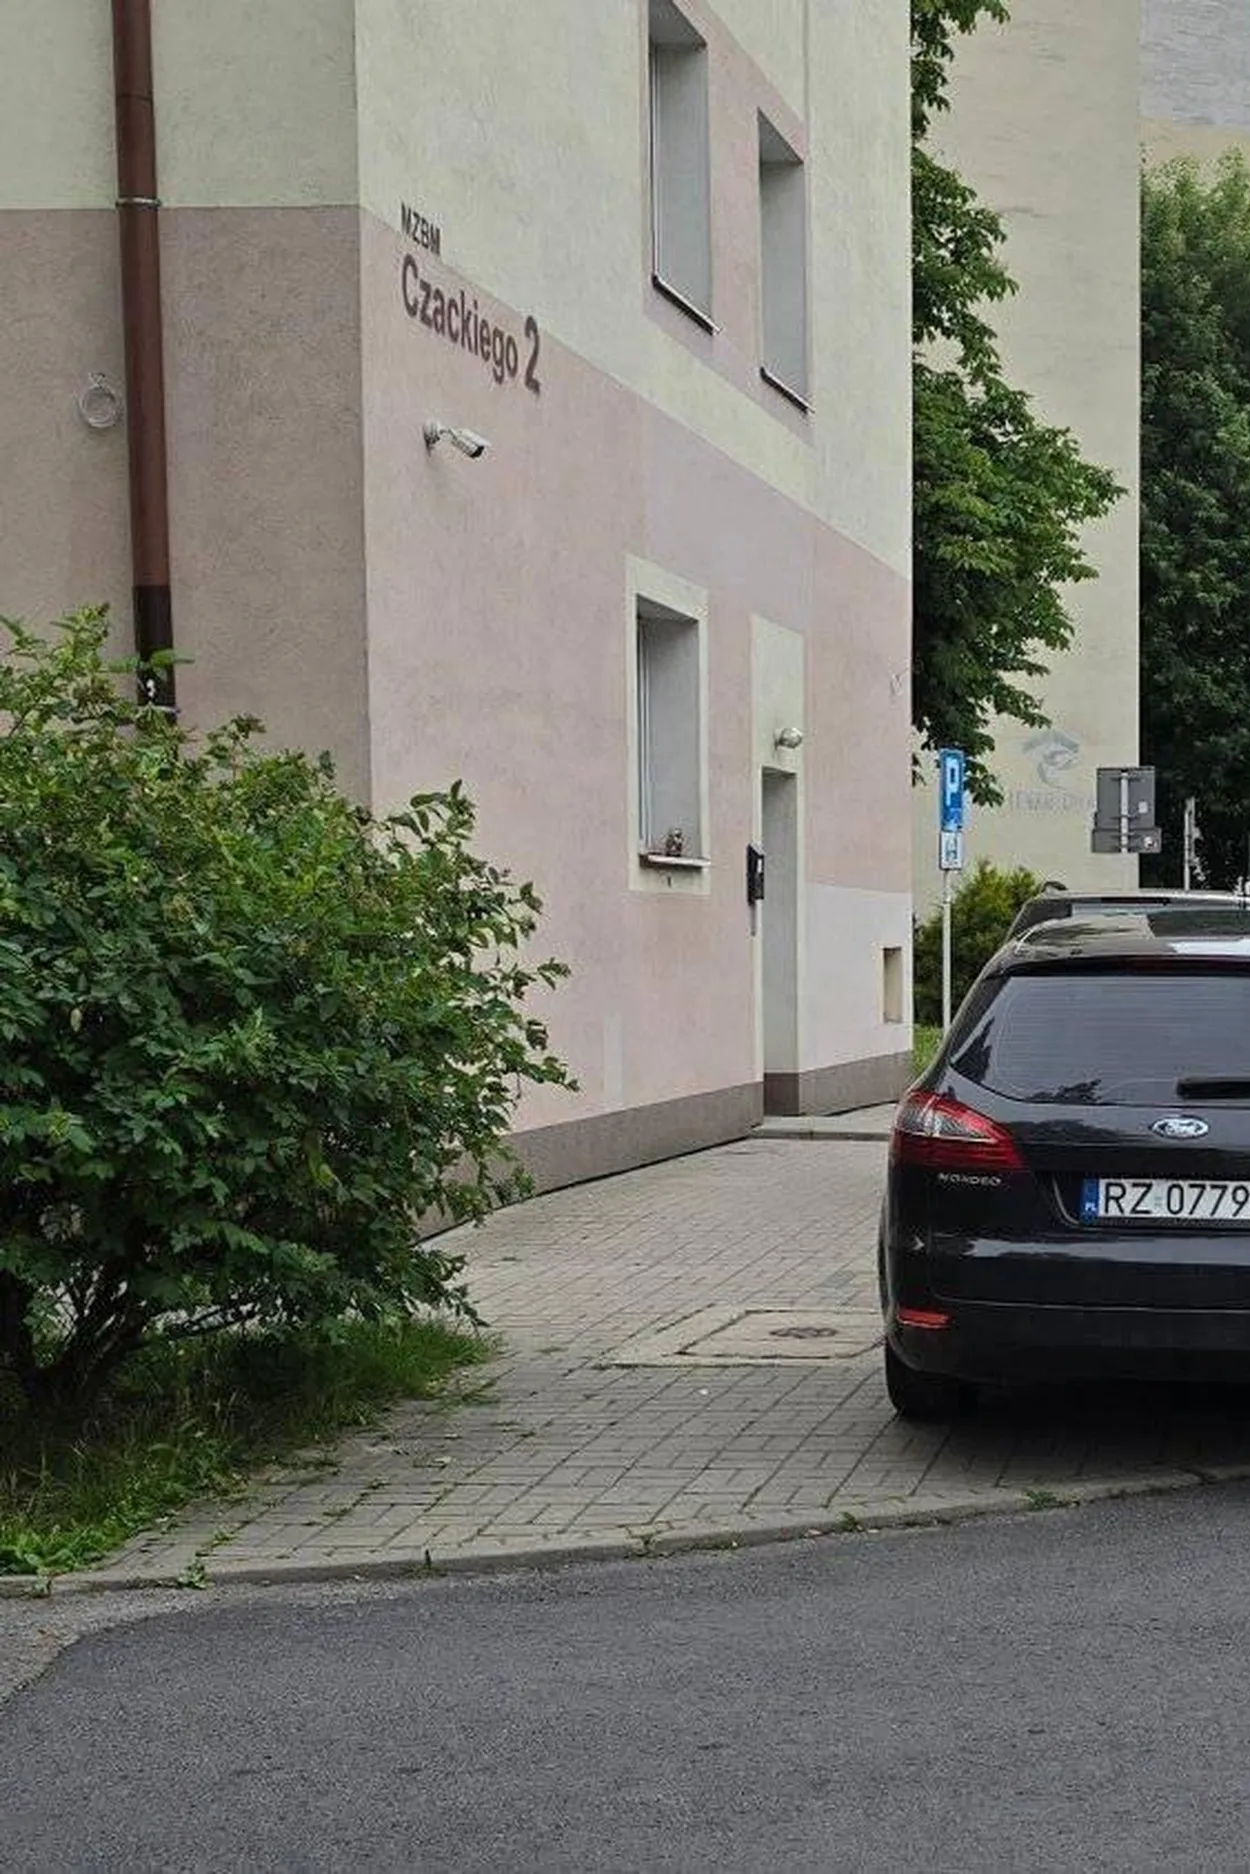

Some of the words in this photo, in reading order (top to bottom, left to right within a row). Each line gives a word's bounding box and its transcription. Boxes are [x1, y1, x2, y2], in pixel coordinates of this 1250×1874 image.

[401, 202, 440, 255] MZBM
[402, 253, 518, 385] Czackiego
[524, 315, 541, 398] 2
[946, 756, 960, 807] P
[1104, 1182, 1153, 1215] RZ
